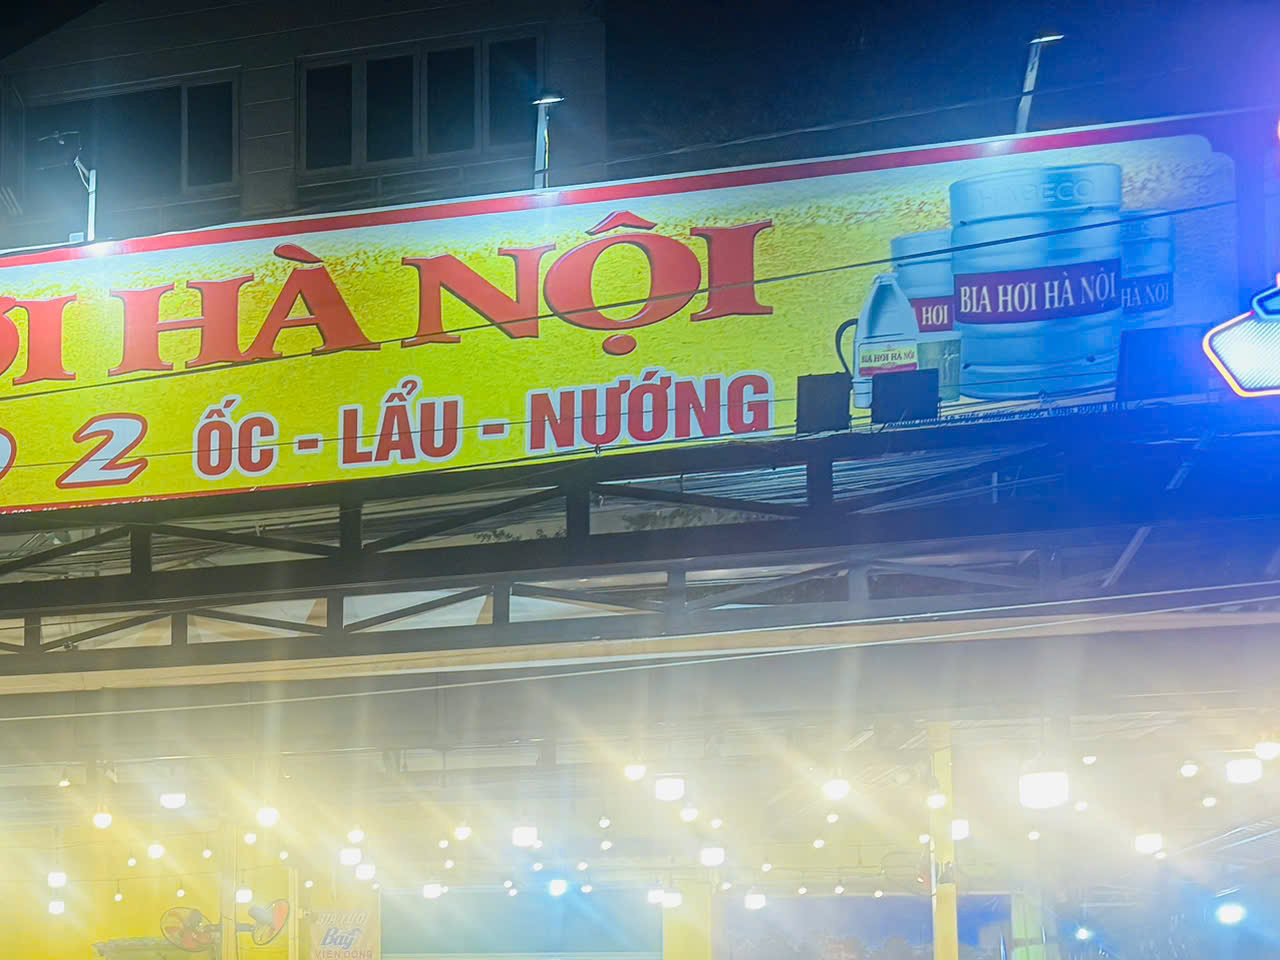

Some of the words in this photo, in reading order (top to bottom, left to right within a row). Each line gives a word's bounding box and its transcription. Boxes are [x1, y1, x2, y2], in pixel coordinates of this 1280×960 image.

[109, 242, 380, 376] HÀ
[401, 210, 773, 356] NỘI
[960, 285, 992, 313] BIA
[997, 281, 1037, 312] HƠI
[1044, 271, 1075, 309] HÀ
[1080, 267, 1116, 308] NỘI
[56, 413, 148, 489] 2
[195, 396, 277, 476] ỐC
[341, 378, 461, 466] LẨU
[528, 369, 771, 452] NƯỚNG
